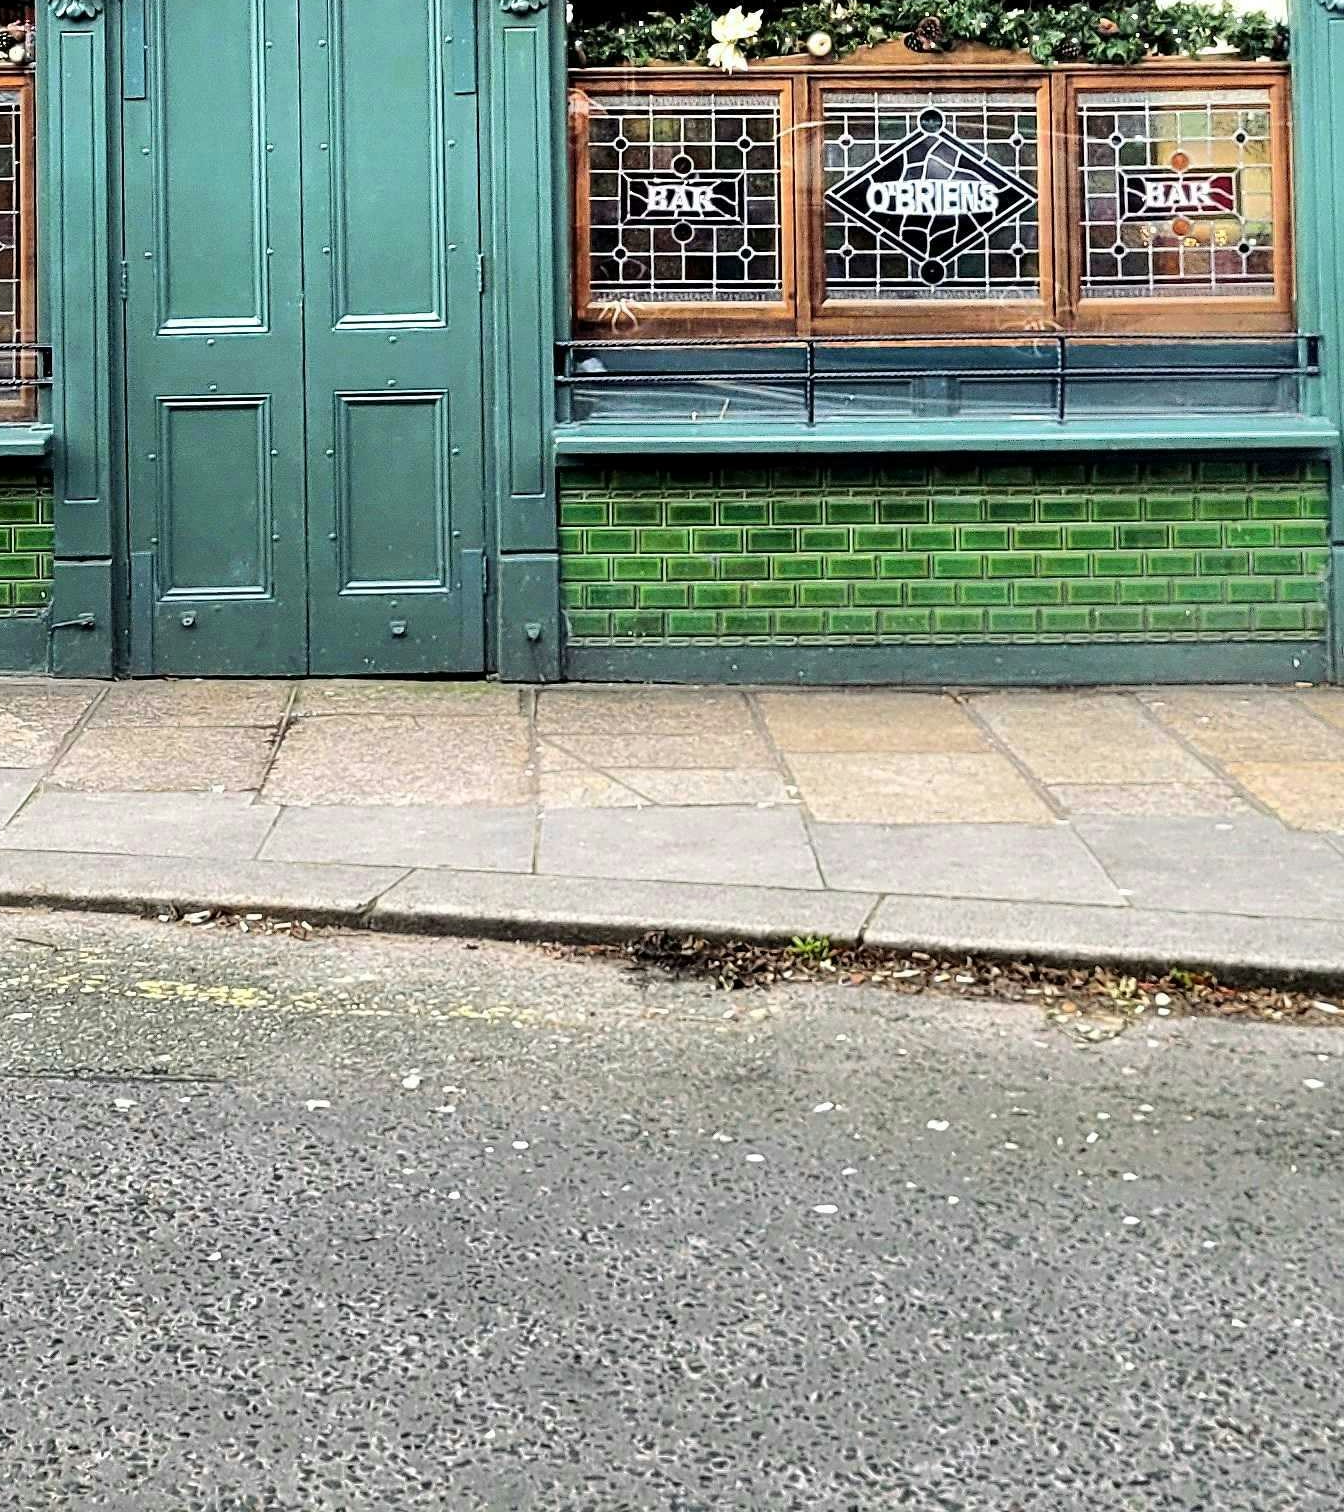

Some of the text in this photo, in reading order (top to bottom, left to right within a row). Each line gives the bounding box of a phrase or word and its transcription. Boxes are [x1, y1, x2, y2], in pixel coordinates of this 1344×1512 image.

[646, 184, 718, 212] BAR
[865, 178, 1000, 216] O'BRIENS
[1145, 181, 1216, 207] BAR
